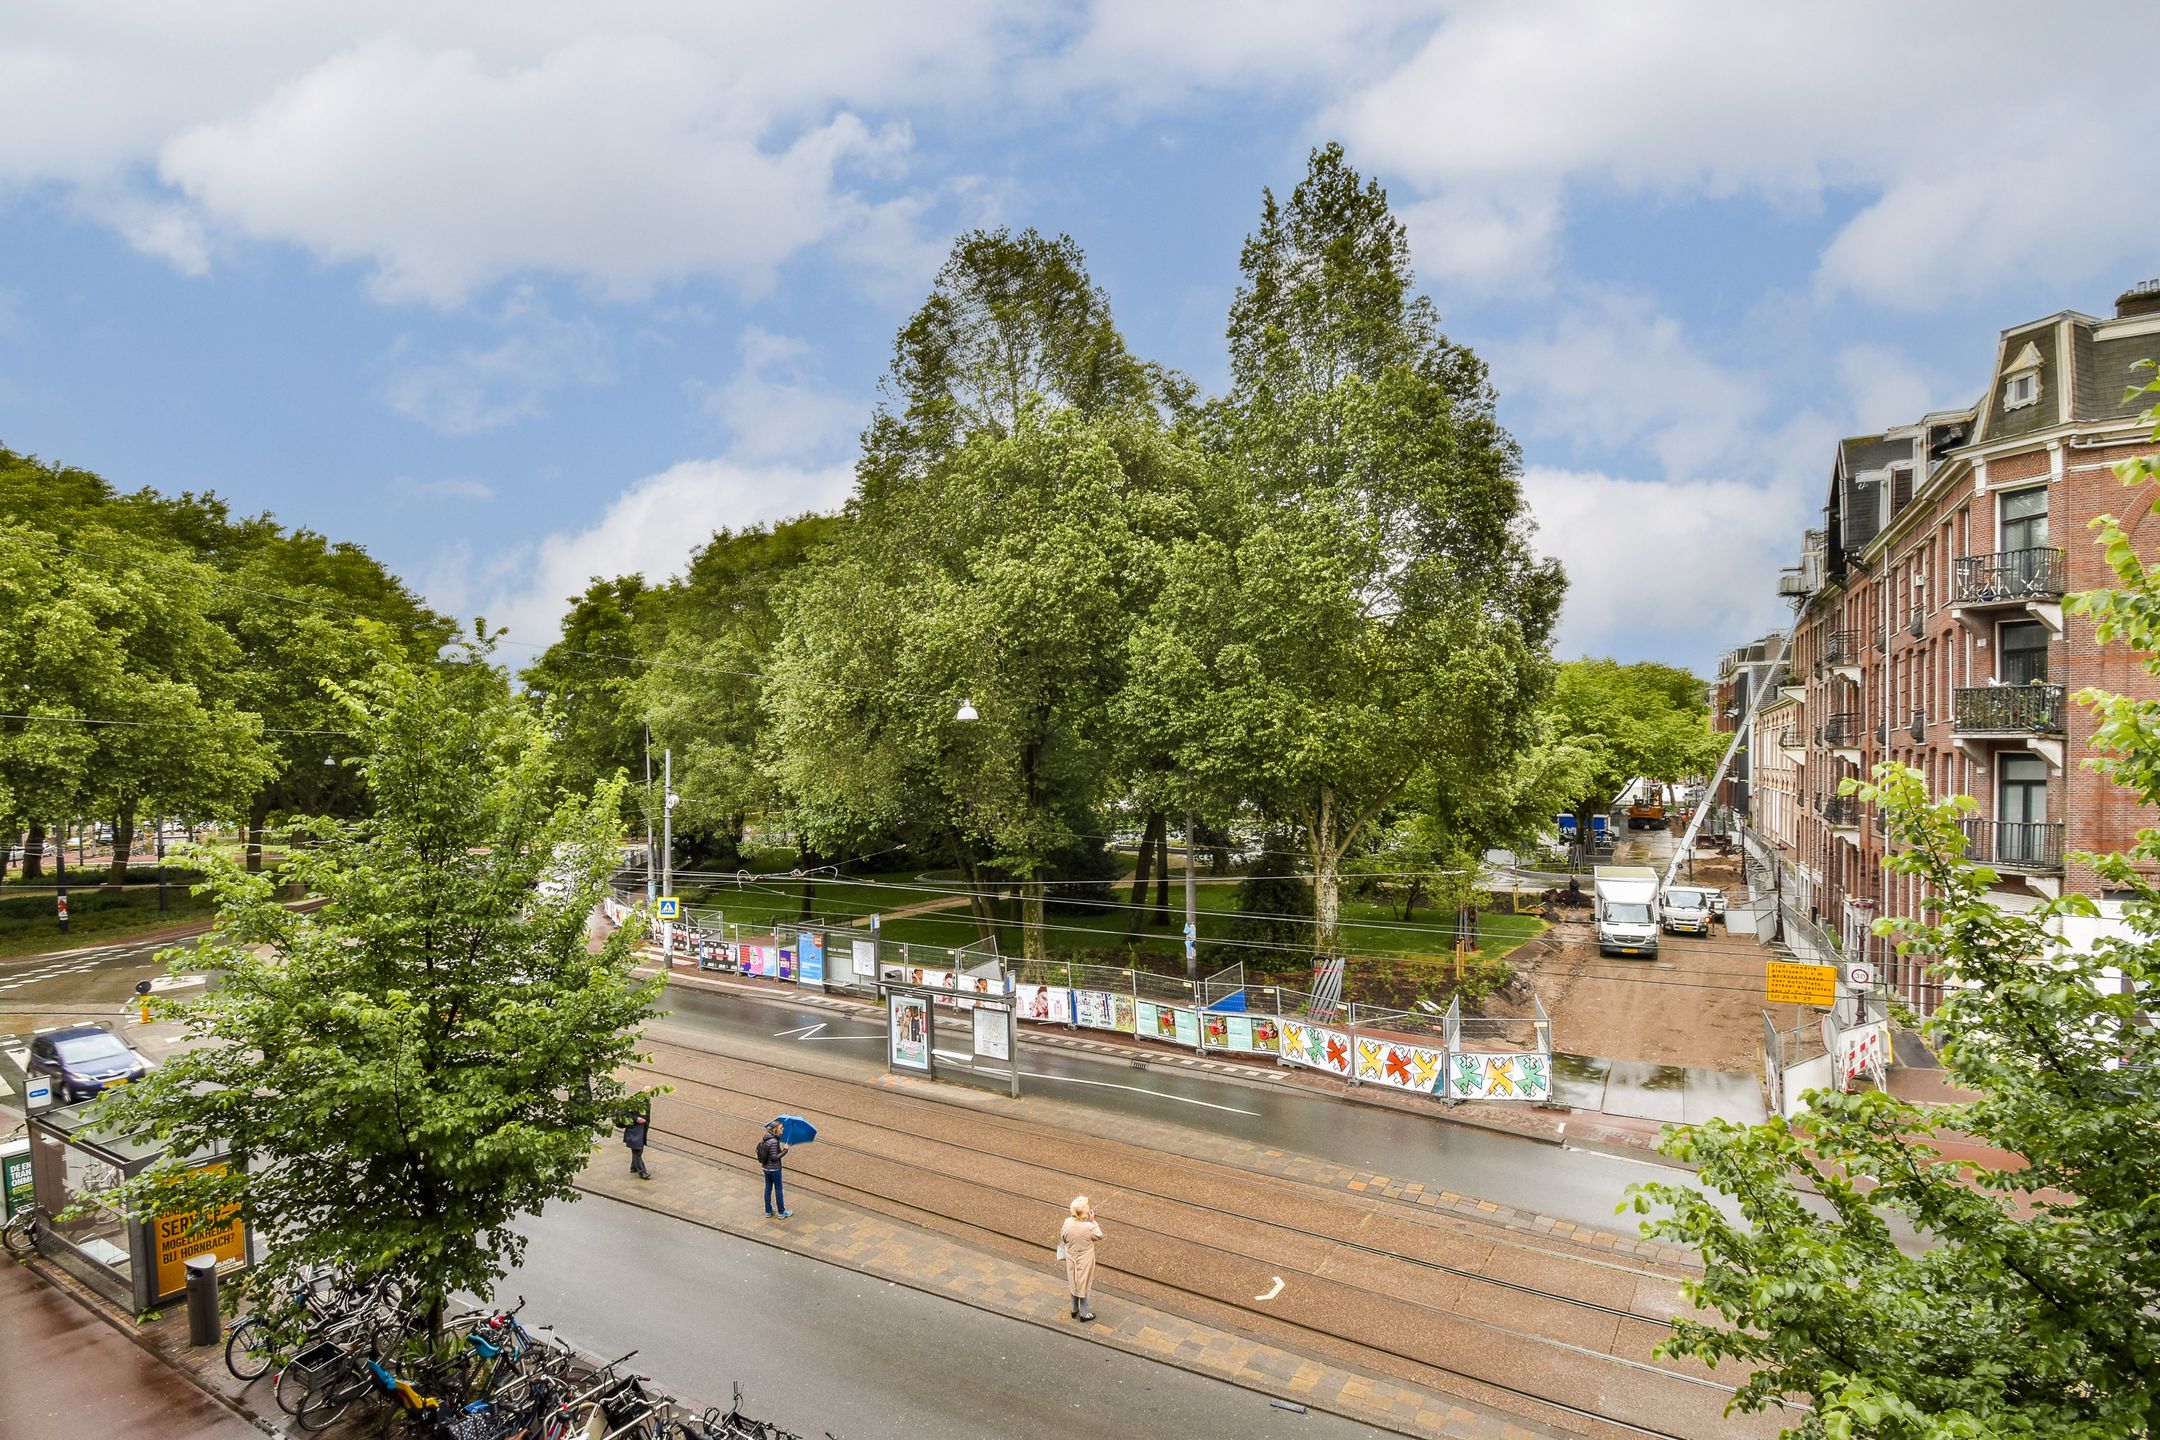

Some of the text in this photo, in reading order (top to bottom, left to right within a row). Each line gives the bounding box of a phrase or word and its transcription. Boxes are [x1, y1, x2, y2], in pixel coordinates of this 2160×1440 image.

[1854, 972, 1866, 980] 30
[10, 1163, 21, 1173] DE
[162, 1232, 235, 1265] BIJ HORNBACH?
